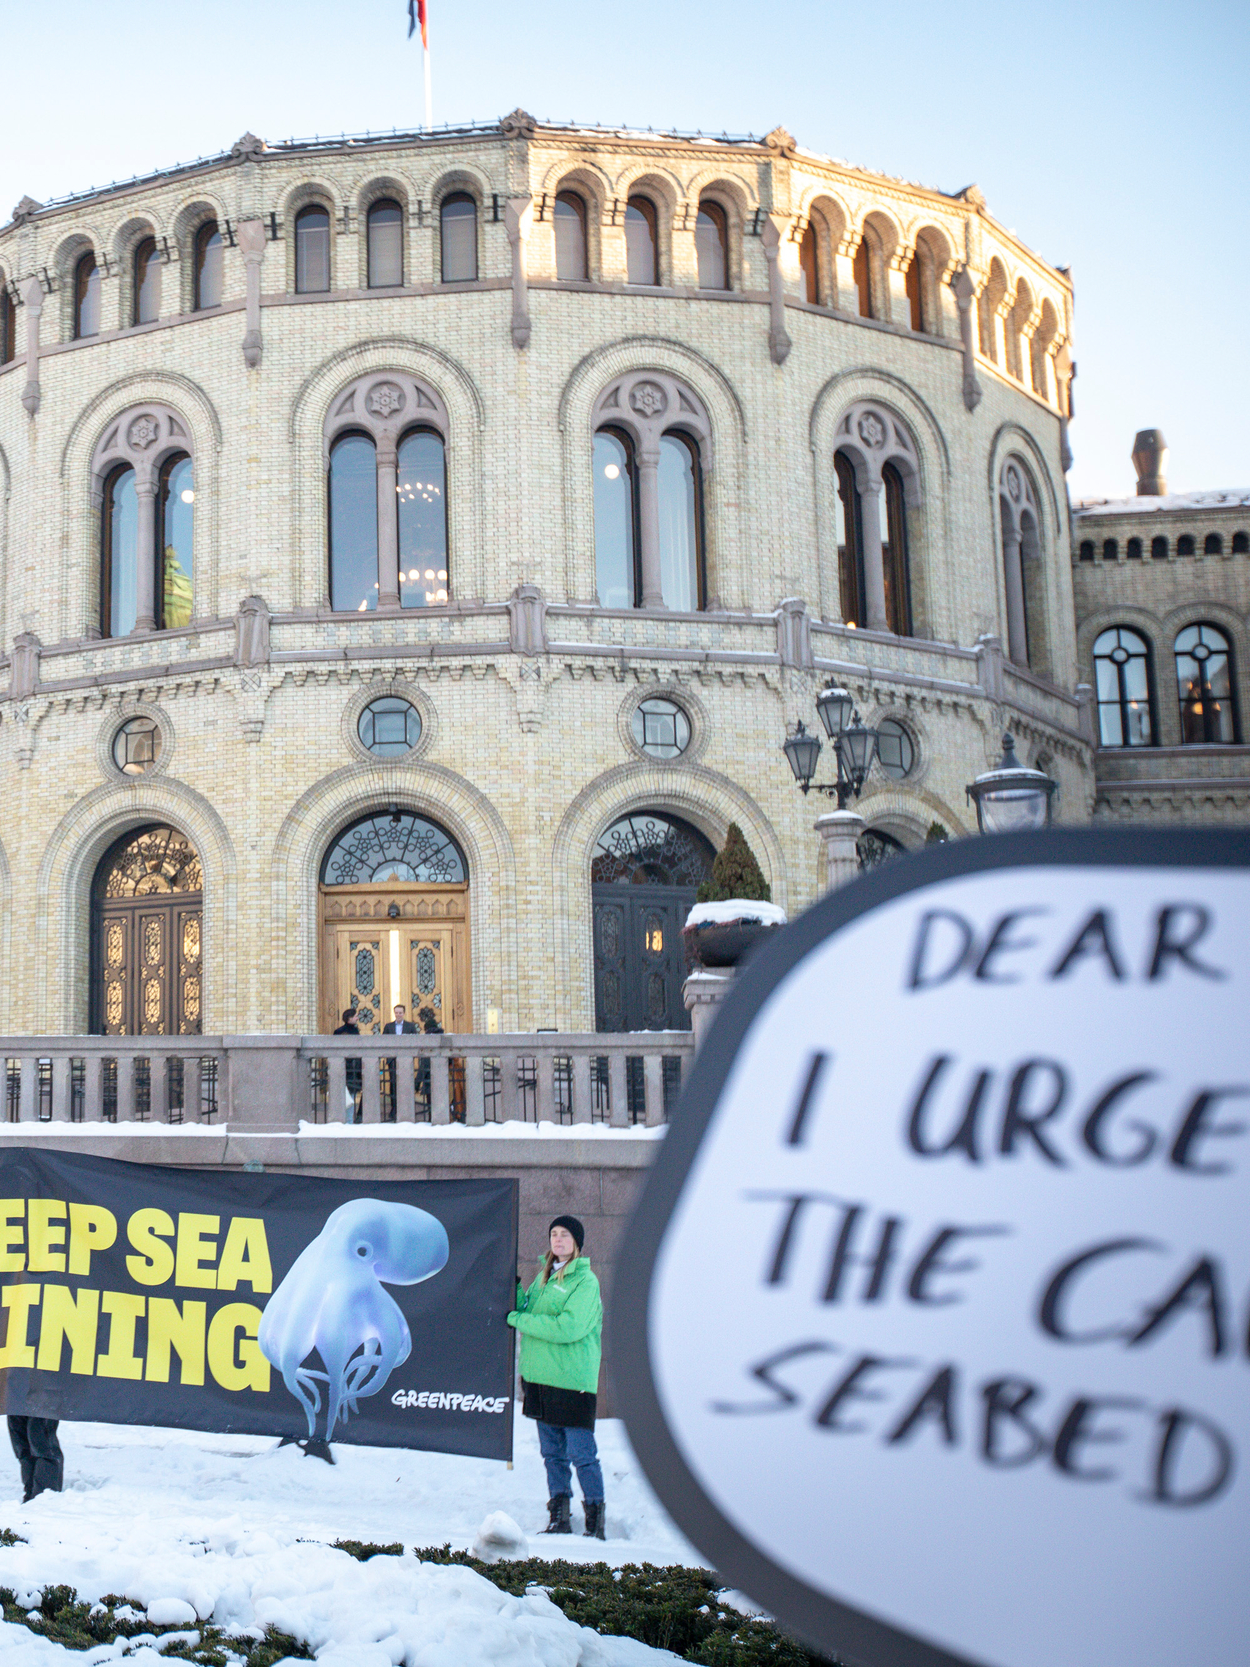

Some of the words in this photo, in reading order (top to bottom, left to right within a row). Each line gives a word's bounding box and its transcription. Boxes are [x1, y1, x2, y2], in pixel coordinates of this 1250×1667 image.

[904, 903, 1228, 993] DEAR
[784, 1048, 833, 1148] I
[904, 1053, 1250, 1177] URGE
[125, 1207, 274, 1294] SEA
[742, 1187, 1014, 1306] THE
[1034, 1234, 1250, 1366] CA
[391, 1389, 510, 1413] GREENPEACE
[707, 1340, 1238, 1511] SEABED
